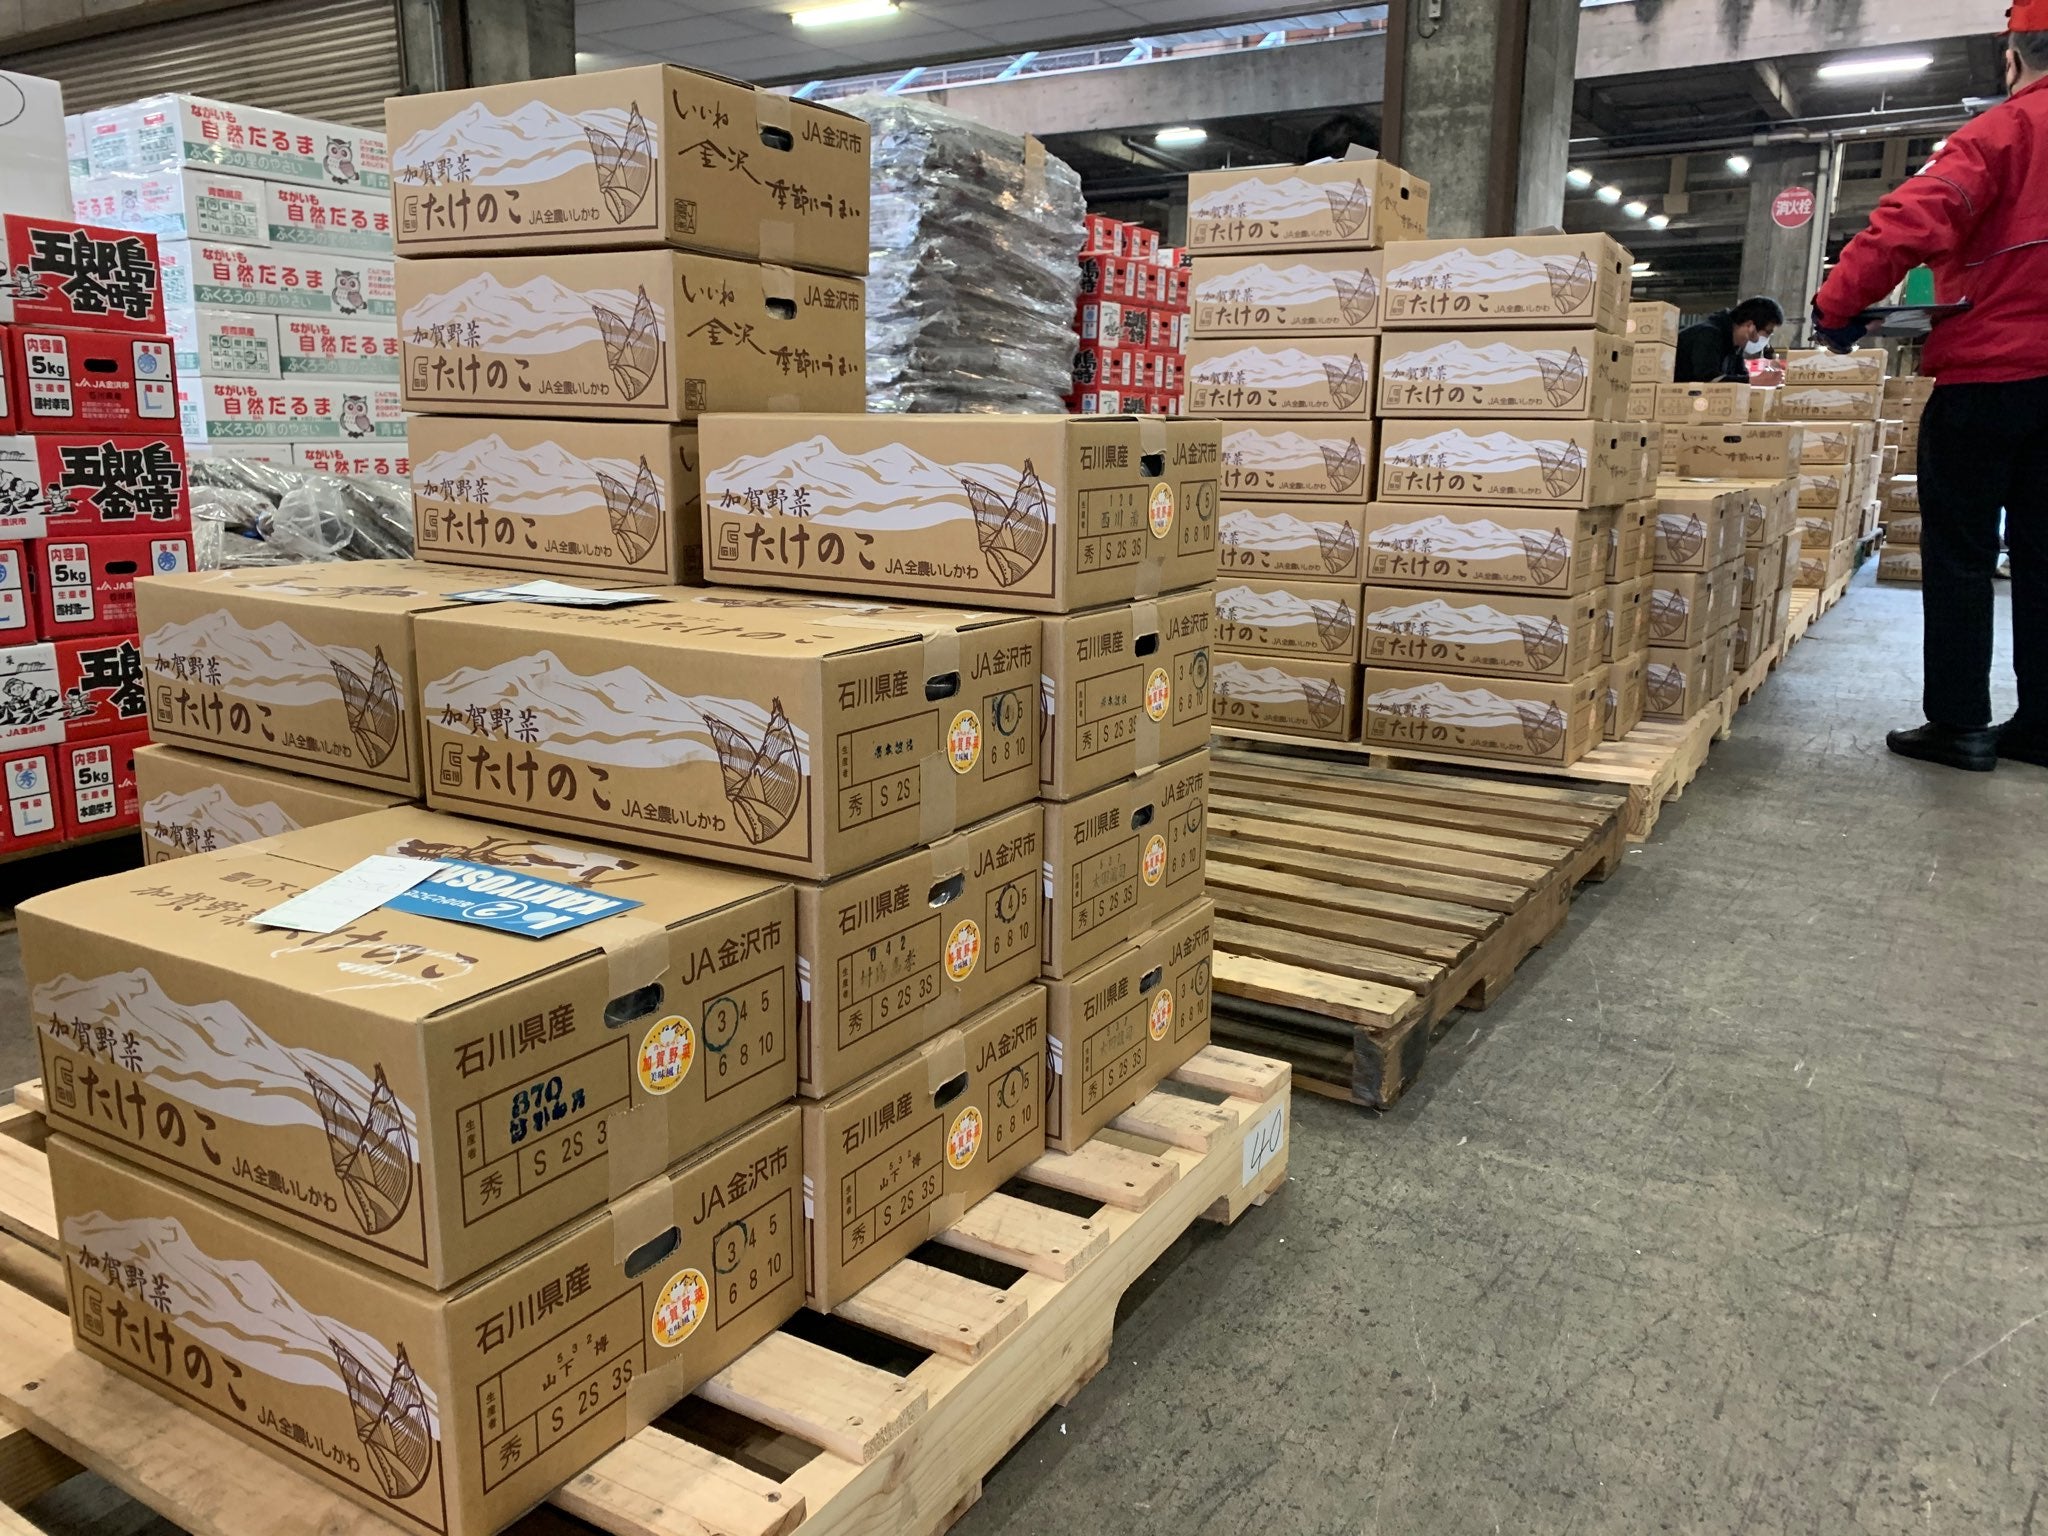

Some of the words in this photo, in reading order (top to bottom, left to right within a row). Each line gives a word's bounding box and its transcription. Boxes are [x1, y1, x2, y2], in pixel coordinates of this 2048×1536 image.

[191, 104, 237, 123] ながいも
[673, 89, 729, 127] いいね
[201, 119, 315, 155] 自然だるま
[801, 119, 862, 154] JA金沢市
[402, 154, 472, 185] 加賀野菜
[678, 139, 762, 186] 金沢
[278, 190, 319, 206] ながいも
[421, 187, 522, 232] たけのこ
[1776, 199, 1812, 216] 消火栓
[287, 203, 390, 231] 自然だるま
[1210, 221, 1280, 243] たけのこ
[202, 248, 248, 264] ながいも
[213, 262, 323, 289] 自然だるま
[682, 274, 735, 305] いいね
[803, 284, 860, 312] JA金沢市
[1408, 293, 1490, 316] たけのこ
[290, 322, 330, 335] ながいも
[1216, 306, 1287, 326] たけのこ
[27, 338, 64, 354] 内容量
[299, 335, 399, 355] 自然だるま
[412, 319, 481, 349] 加賀野菜
[687, 316, 766, 356] 金沢
[32, 356, 65, 377] 5kg
[430, 354, 532, 393] たけのこ
[214, 385, 257, 397] ながいも
[224, 397, 331, 415] 自然だるま
[1209, 388, 1278, 408] たけのこ
[1404, 384, 1484, 406] たけのこ
[305, 450, 344, 460] ながいも
[1080, 444, 1129, 471] 石川県産
[1173, 442, 1218, 466] JA金沢市
[423, 477, 490, 503] 加賀野菜
[1220, 468, 1276, 488] けのこ
[1405, 471, 1484, 493] たけのこ
[719, 486, 811, 518] 加賀野菜
[440, 507, 538, 550] たけのこ
[51, 548, 86, 561] 内容量
[743, 522, 876, 571] たけのこ
[1084, 543, 1095, 564] 秀
[1106, 542, 1112, 560] S
[1117, 540, 1127, 559] 2S
[1132, 537, 1142, 556] 3S
[55, 564, 86, 583] 5kg
[1389, 556, 1469, 578] たけのこ
[1165, 611, 1209, 641] JA金沢市
[1076, 630, 1124, 662] 石川県産
[1388, 638, 1467, 661] たけのこ
[154, 652, 221, 686] 加賀野菜
[970, 644, 1032, 681] JA金沢市
[837, 670, 909, 712] 石川県産
[175, 687, 275, 743] たけのこ
[440, 702, 540, 743] 加賀野菜
[1082, 729, 1092, 751] 秀
[1103, 724, 1110, 743] S
[1114, 721, 1124, 739] 2S
[1389, 721, 1466, 743] たけのこ
[75, 749, 108, 766] 内容量
[79, 768, 109, 785] 5kg
[466, 744, 611, 811] たけのこ
[1161, 773, 1204, 808] JA金沢市
[848, 793, 863, 819] 秀
[880, 785, 889, 807] S
[896, 778, 911, 803] 2S
[154, 820, 217, 852] 加賀野菜
[1073, 807, 1120, 846] 石川県産
[974, 831, 1036, 879] JA金沢市
[838, 883, 910, 936] 石川県産
[1078, 908, 1088, 930] 秀
[681, 920, 782, 986] JA金沢市
[1169, 924, 1211, 968] JA金沢市
[739, 1000, 749, 1021] 4
[761, 990, 770, 1013] 5
[880, 997, 889, 1018] S
[897, 986, 912, 1007] 2S
[919, 974, 933, 997] 3S
[1083, 975, 1130, 1022] 石川県産
[848, 1009, 863, 1036] 秀
[48, 1011, 143, 1073] 加賀野菜
[454, 1002, 576, 1080] 石川県産
[719, 1056, 728, 1078] 6
[739, 1044, 749, 1067] 8
[759, 1032, 774, 1057] 10
[975, 1016, 1038, 1073] JA金沢市
[1088, 1081, 1098, 1103] 秀
[78, 1065, 221, 1165] たけのこ
[842, 1091, 913, 1154] 石川県産
[534, 1150, 547, 1179] S
[561, 1132, 584, 1164] 2S
[1250, 1108, 1282, 1172] 40
[480, 1170, 503, 1207] 秀
[693, 1145, 790, 1227] JA金沢市
[884, 1204, 892, 1226] S
[900, 1192, 914, 1216] 2S
[922, 1174, 935, 1199] 3S
[748, 1227, 757, 1249] 4
[769, 1213, 778, 1236] 5
[851, 1222, 866, 1249] 秀
[78, 1244, 173, 1315] 加賀野菜
[729, 1282, 738, 1305] 6
[750, 1269, 758, 1291] 8
[768, 1253, 782, 1278] 10
[475, 1262, 593, 1356] 石川県産
[107, 1299, 247, 1412] たけのこ
[552, 1405, 564, 1434] S
[578, 1382, 599, 1415] 2S
[612, 1358, 633, 1391] 3S
[500, 1436, 523, 1471] 秀
